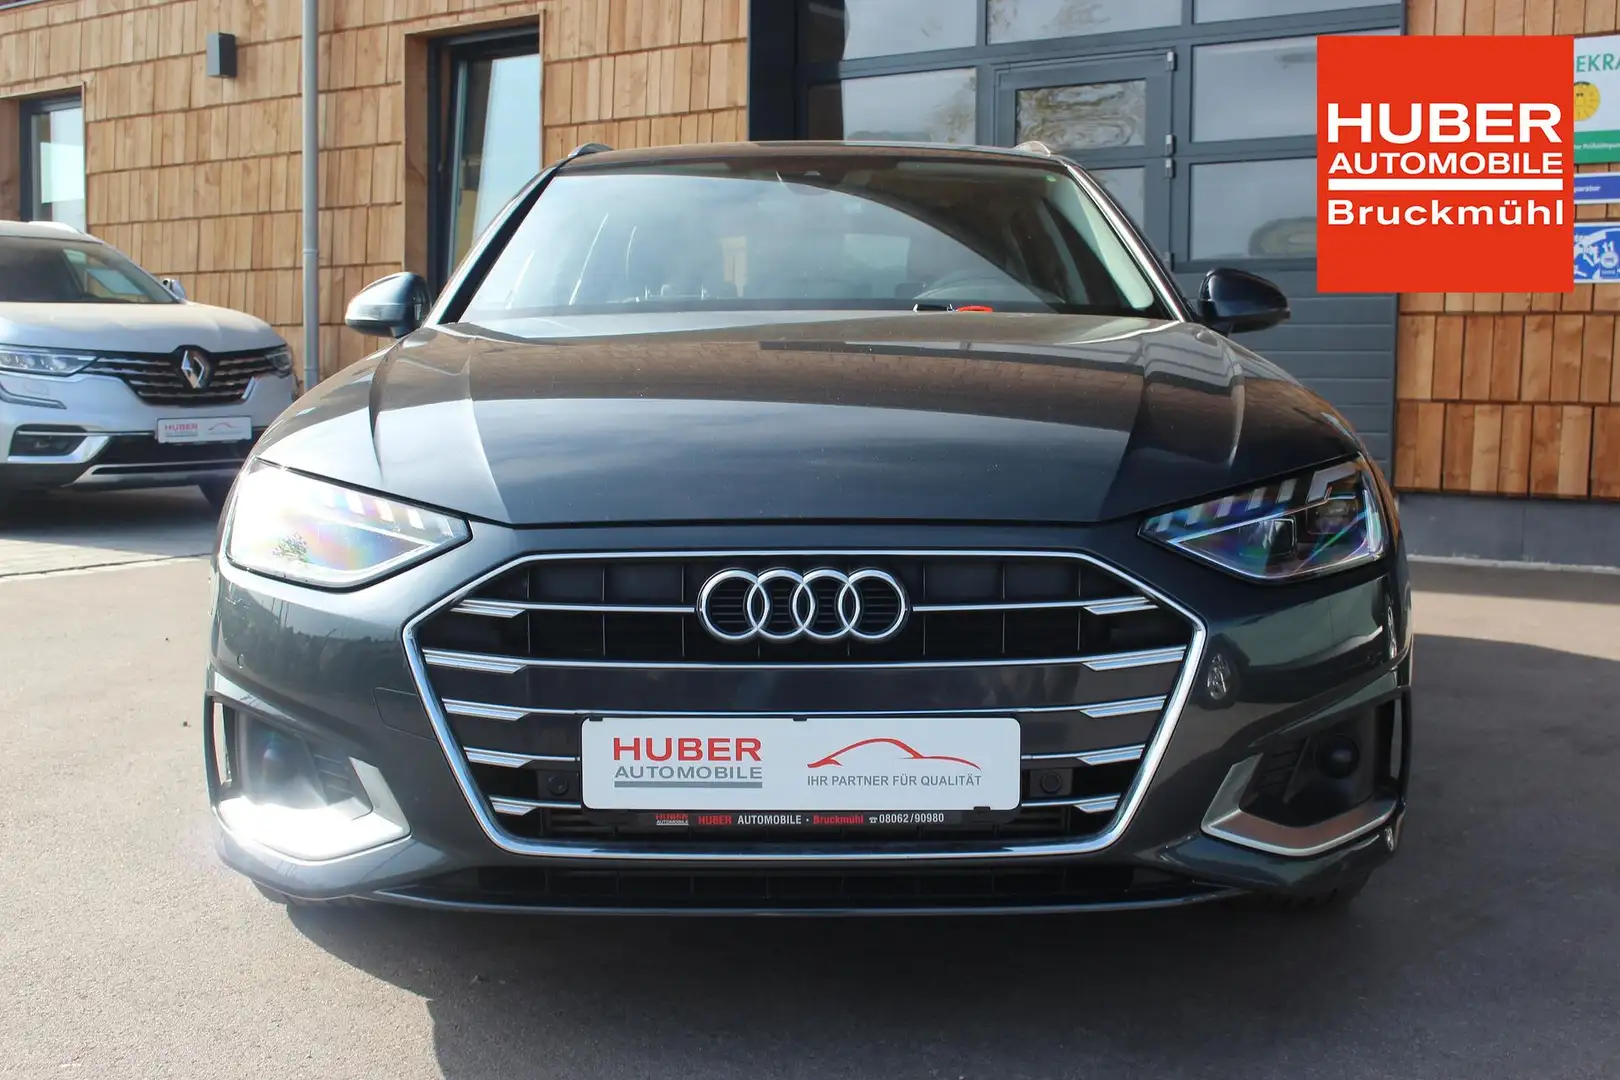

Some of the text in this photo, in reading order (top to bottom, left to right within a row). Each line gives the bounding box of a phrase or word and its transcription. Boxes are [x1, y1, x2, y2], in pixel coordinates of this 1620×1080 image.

[613, 737, 762, 761] HUBER
[614, 766, 763, 779] AUTOMOBILE
[807, 773, 982, 787] IHR PARTNER FÜR QUALITÄT
[698, 815, 732, 825] HUBER
[737, 814, 802, 825] AUTOMOBILE
[878, 812, 945, 824] 08062/90980
